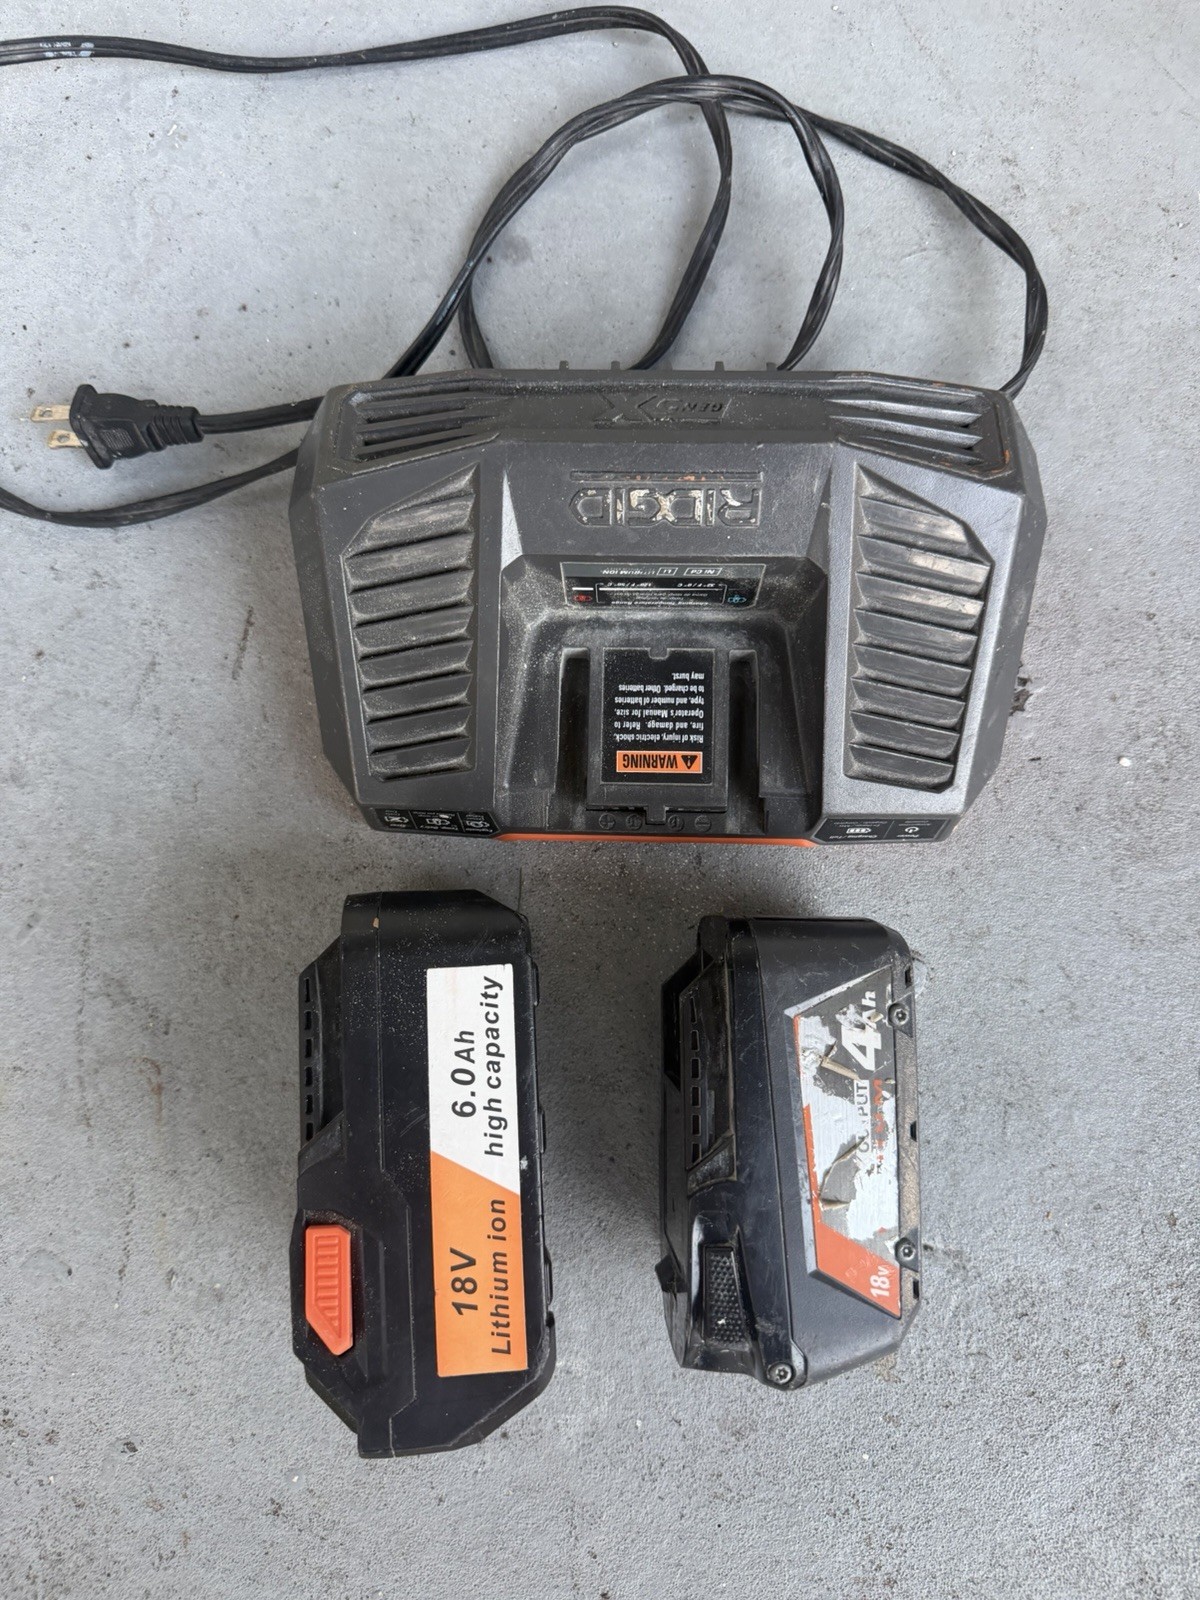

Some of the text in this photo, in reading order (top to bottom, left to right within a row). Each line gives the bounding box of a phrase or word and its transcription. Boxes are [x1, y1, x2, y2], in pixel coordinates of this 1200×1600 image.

[569, 489, 761, 528] RIDGID
[671, 671, 704, 681] may burst.
[618, 683, 704, 693] to be charged. Other batteries
[614, 696, 704, 706] type, and number of batteries
[614, 708, 704, 718] Operator's Manual for size,
[623, 722, 640, 730] Refer
[645, 720, 674, 730] damage.
[676, 722, 688, 731] and
[690, 721, 704, 731] fire,
[613, 733, 704, 743] Risk of injury, electric shock,
[622, 754, 678, 769] WARNING
[479, 976, 507, 1157] high capacity
[450, 1030, 476, 1118] 6.0Ah
[856, 1083, 869, 1153] OUPUT
[449, 1247, 478, 1316] 18V
[487, 1199, 511, 1355] Lithium ion
